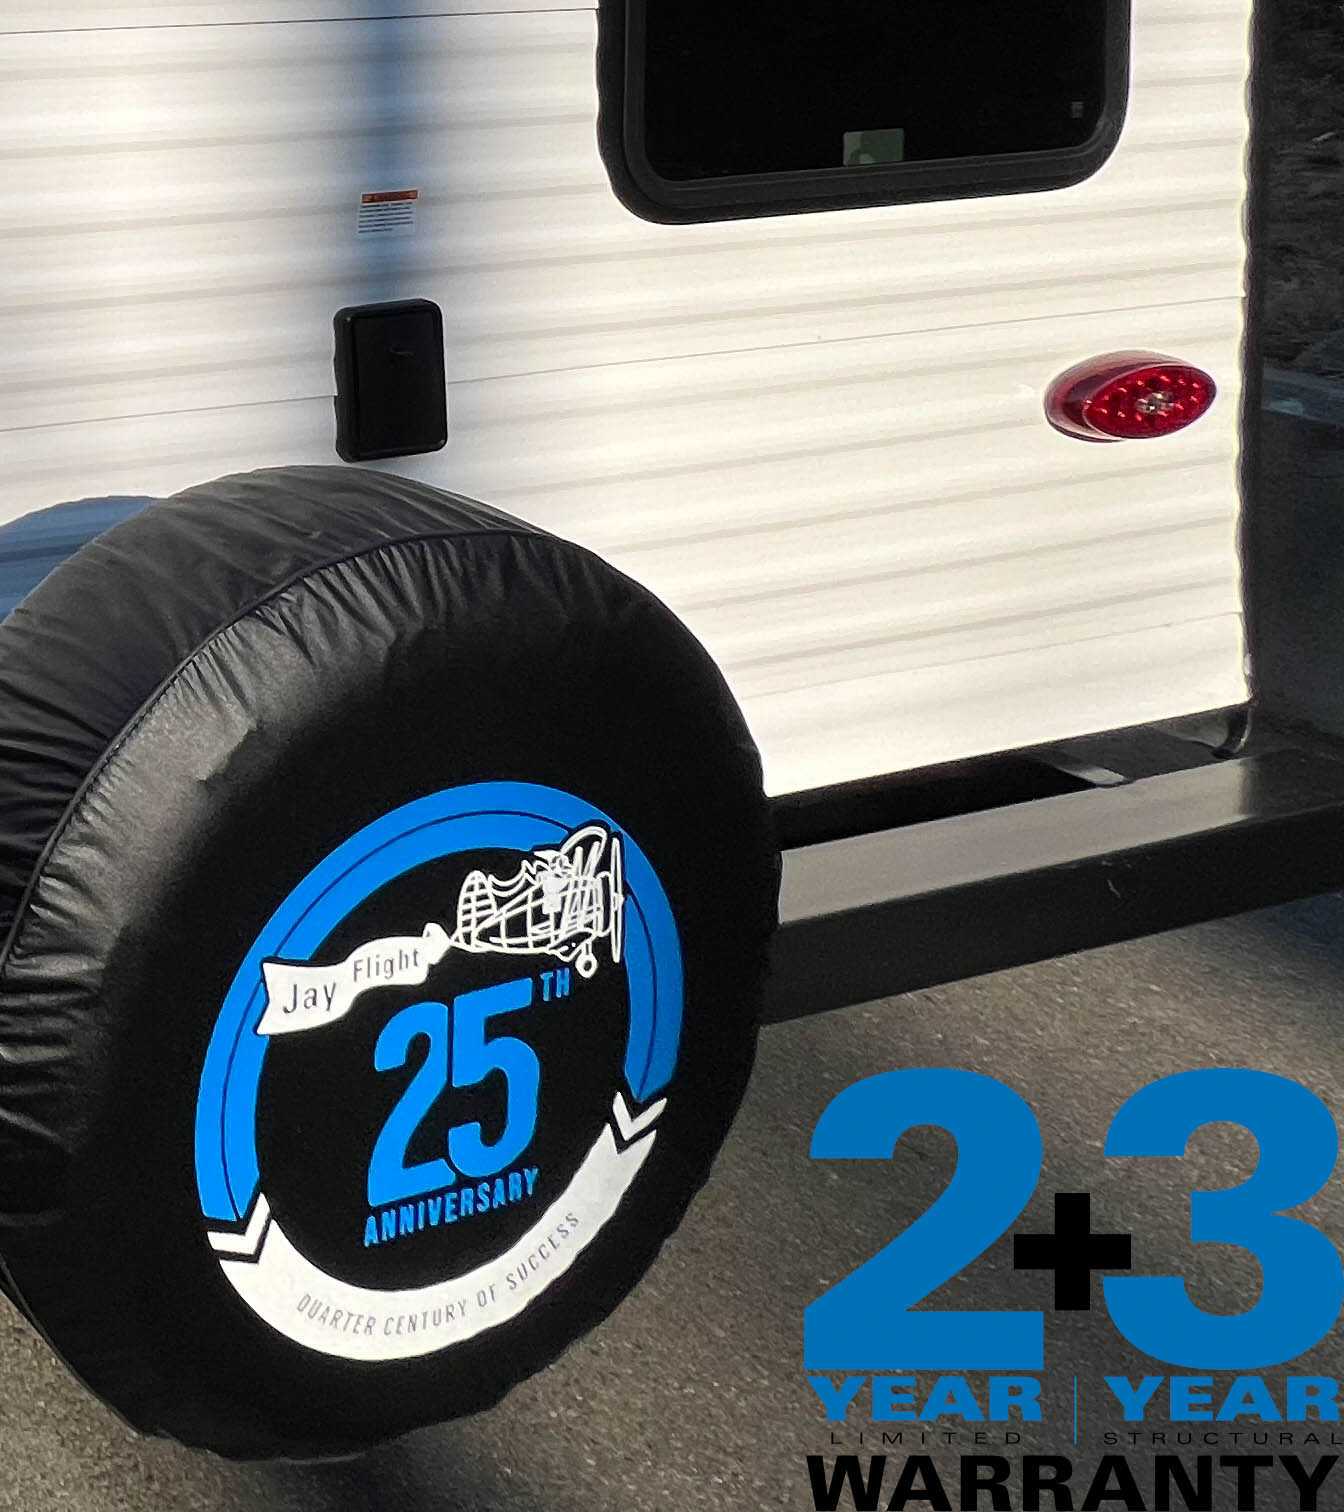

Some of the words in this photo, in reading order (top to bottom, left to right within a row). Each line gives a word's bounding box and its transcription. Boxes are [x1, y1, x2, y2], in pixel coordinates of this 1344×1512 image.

[282, 982, 337, 1014] Jay
[353, 948, 419, 983] Flight
[363, 1167, 540, 1248] ANNIVERSARY
[296, 1293, 377, 1336] QUARTER
[382, 1298, 467, 1336] CENTURY
[476, 1283, 497, 1308] OF
[505, 1212, 579, 1290] SUCCESS
